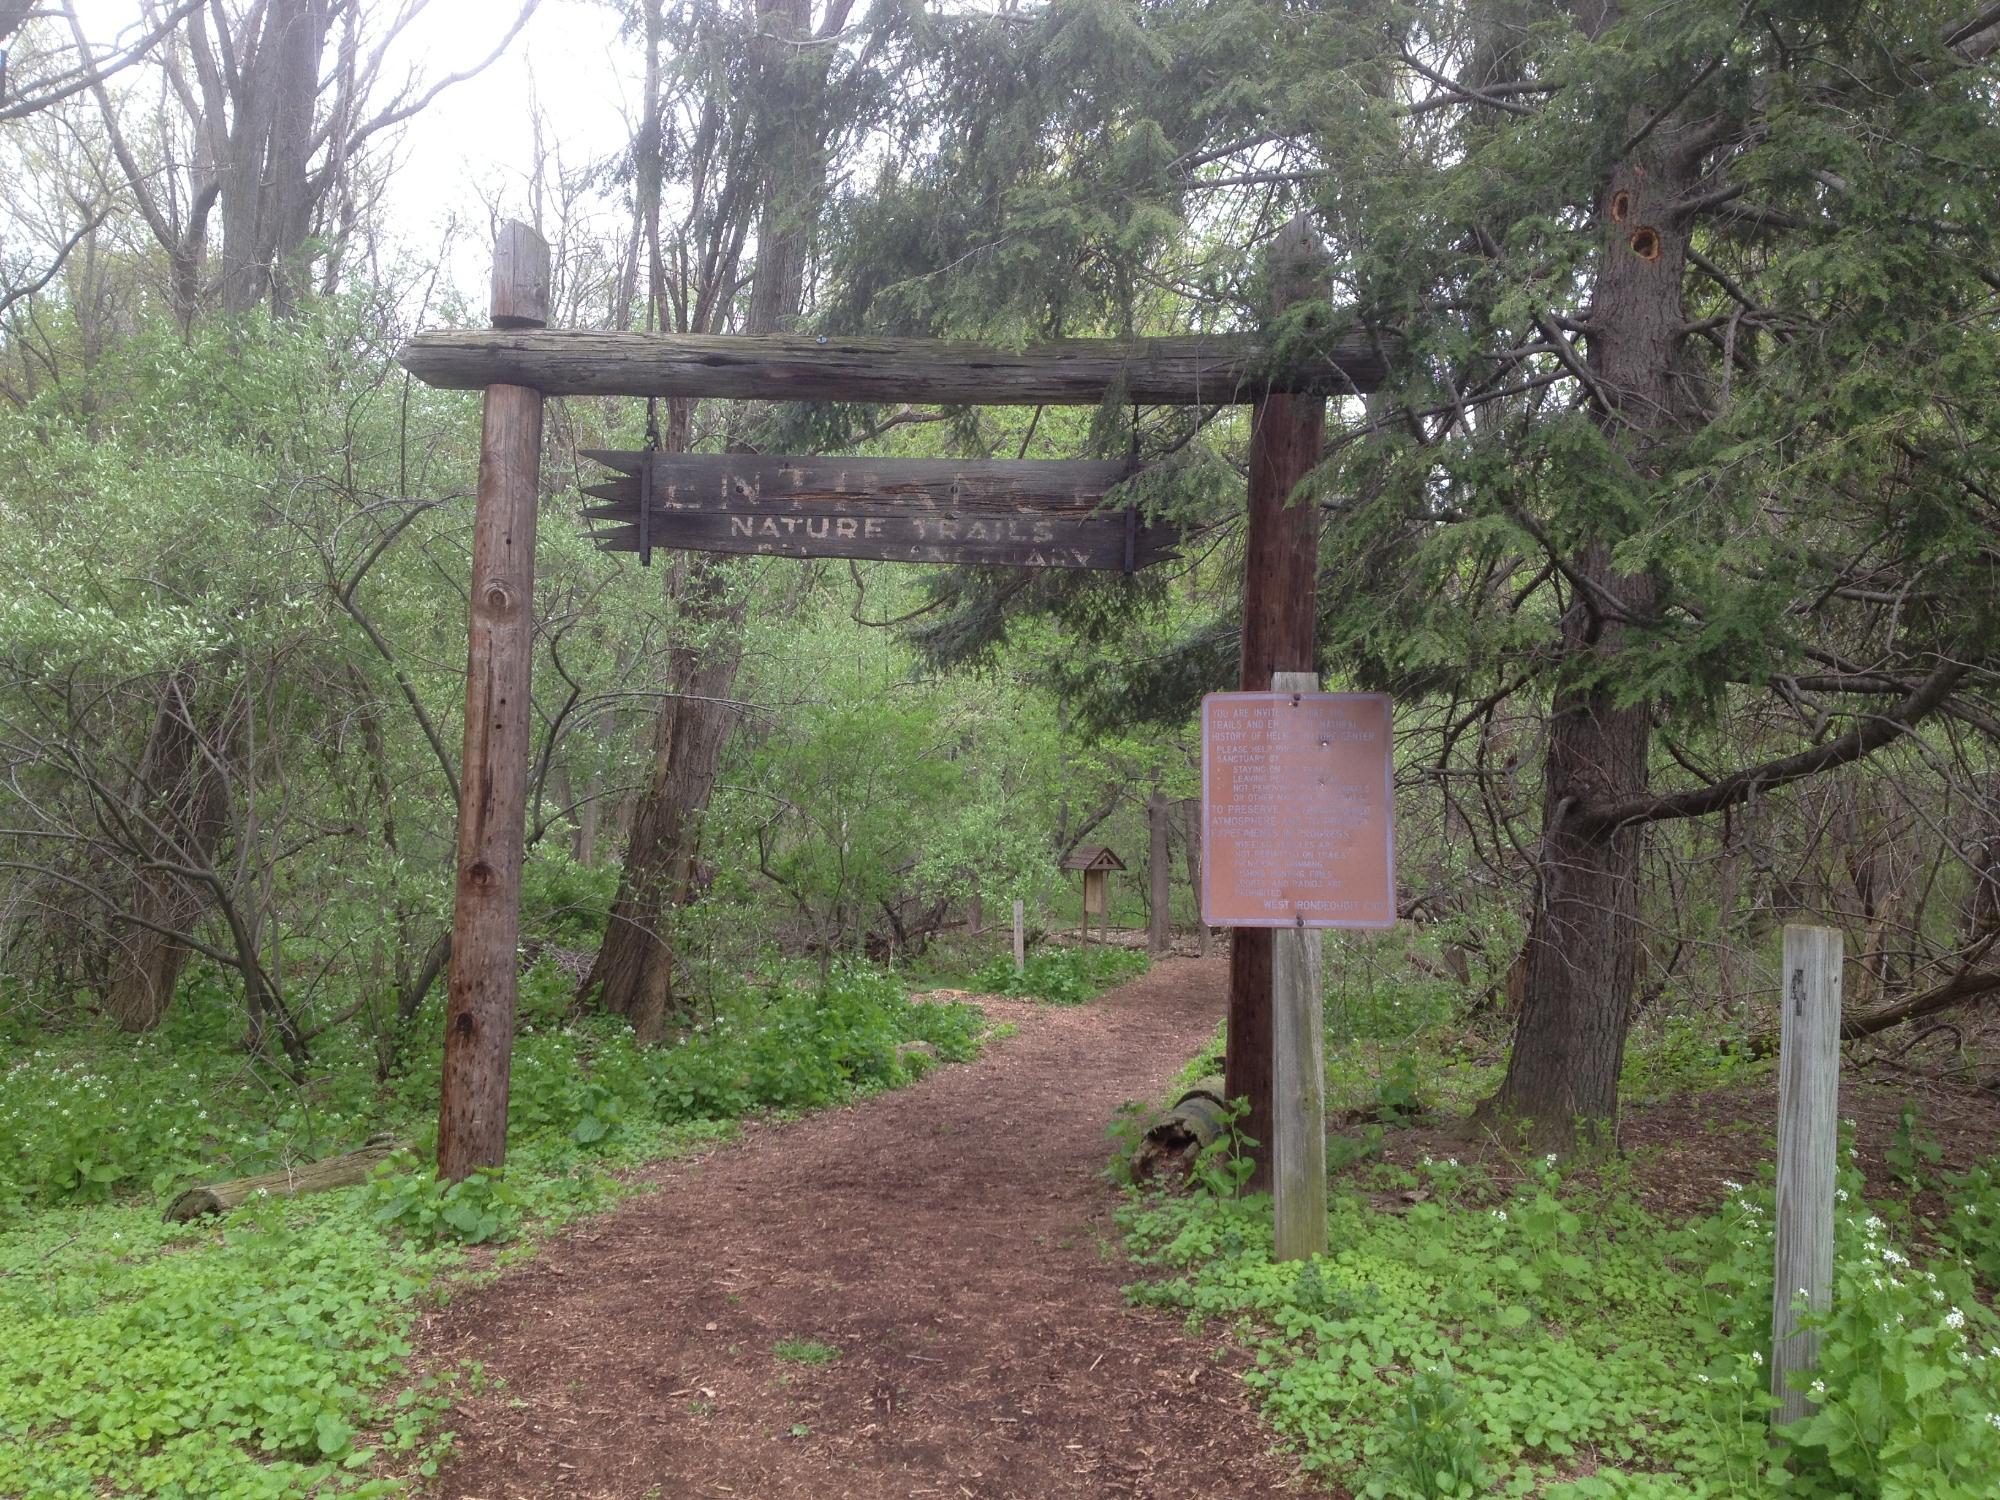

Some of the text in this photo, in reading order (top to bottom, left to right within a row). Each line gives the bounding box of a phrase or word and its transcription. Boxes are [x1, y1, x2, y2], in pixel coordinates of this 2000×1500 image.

[731, 516, 1054, 543] NATURE TRAILS
[1233, 708, 1249, 717] ARE
[1212, 720, 1242, 730] TRAILS
[1247, 720, 1264, 729] AND
[1212, 731, 1247, 741] HISTORY
[1252, 732, 1263, 741] OF
[1216, 745, 1249, 753] PLEASE
[1216, 755, 1265, 764] SANCTUARY
[1233, 765, 1266, 774] STAYING
[1233, 785, 1248, 793] NOT
[1228, 804, 1280, 814] PRESERVE
[1264, 900, 1289, 910] WEST
